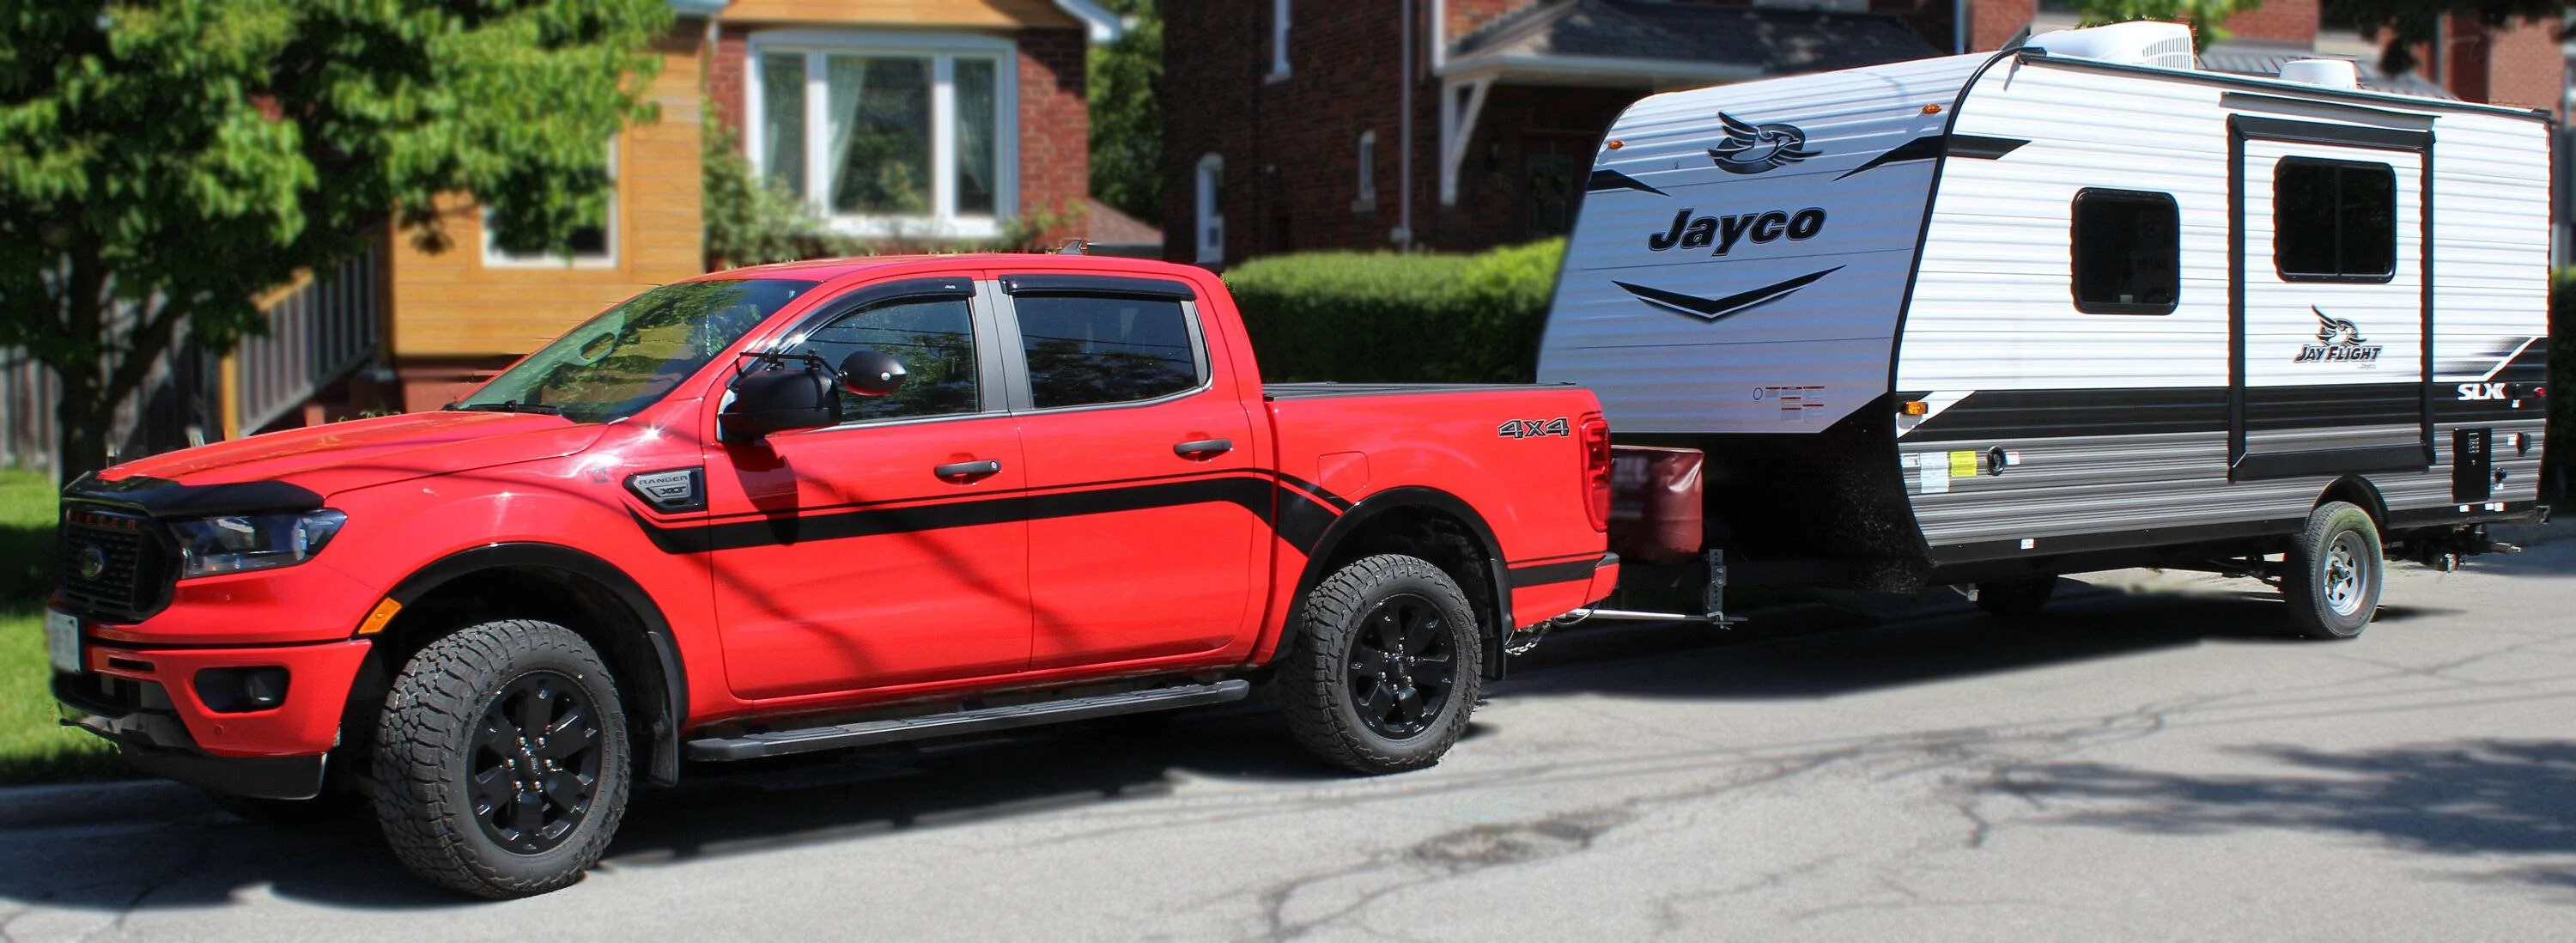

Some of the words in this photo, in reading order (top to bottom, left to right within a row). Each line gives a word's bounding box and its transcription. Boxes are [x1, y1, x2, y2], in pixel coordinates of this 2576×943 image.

[1648, 207, 1827, 257] Jayco
[2293, 344, 2325, 362] JAY
[2324, 344, 2383, 362] FLIGHT
[639, 475, 689, 485] RANGER
